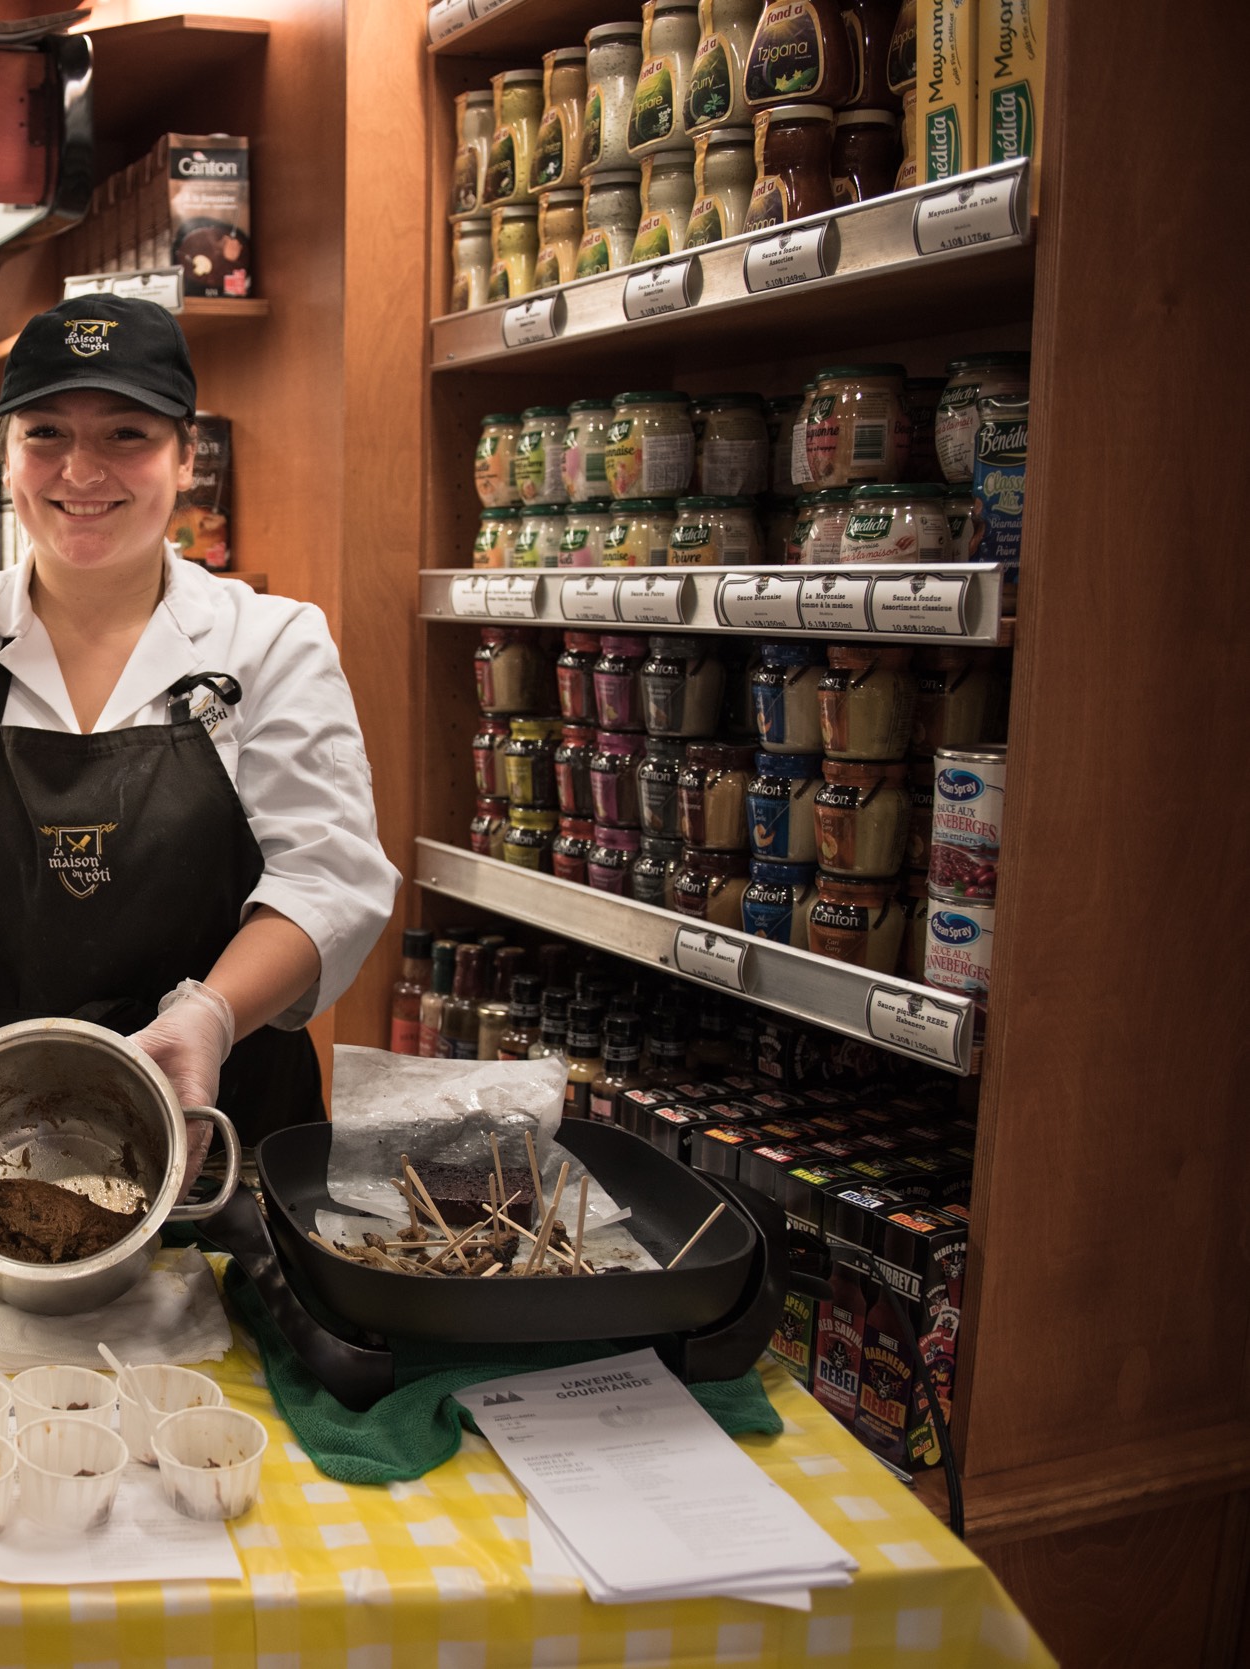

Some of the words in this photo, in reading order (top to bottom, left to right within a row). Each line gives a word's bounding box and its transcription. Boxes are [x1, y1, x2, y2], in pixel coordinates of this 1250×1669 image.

[767, 8, 792, 26] fond
[993, 0, 1017, 78] Mayon
[758, 40, 808, 63] Tzigana
[929, 0, 947, 103] Mayonna
[691, 74, 715, 92] Curry
[996, 91, 1018, 164] nédicta
[931, 116, 949, 181] nédicta
[178, 157, 238, 177] Canton
[928, 203, 968, 218] Mayonnaise
[980, 195, 998, 206] Tube
[762, 250, 778, 260] Sauce
[783, 244, 802, 255] fondue
[64, 334, 103, 346] maison
[91, 341, 110, 352] rôti
[807, 426, 840, 441] gnonne
[979, 424, 1028, 457] Bénédic
[990, 514, 1023, 528] Béarnais
[996, 531, 1021, 543] Tartare
[671, 552, 701, 563] Poivre
[996, 545, 1017, 556] Poivre
[737, 593, 753, 602] Sauce
[754, 592, 782, 601] Béarnaise
[805, 592, 814, 600] La
[892, 593, 912, 602] Sauce
[918, 593, 942, 602] fondue
[881, 603, 920, 611] Assortiment
[921, 604, 953, 612] classique
[201, 705, 216, 719] on
[747, 782, 781, 796] Canton
[939, 775, 954, 796] Ocean
[953, 779, 977, 797] Spray
[816, 790, 848, 805] Canton
[957, 806, 976, 818] AUX
[934, 812, 997, 844] NNEBERGES
[950, 834, 978, 846] entiers
[53, 847, 65, 857] La
[49, 855, 102, 869] maison
[84, 867, 111, 883] rôti
[674, 874, 701, 894] Canton
[746, 888, 784, 903] Canton
[814, 909, 860, 928] Canton
[932, 918, 950, 937] Ocean
[949, 921, 972, 939] Spray
[680, 942, 694, 951] Sauce
[699, 947, 715, 957] fondue
[825, 943, 841, 953] Curry
[827, 938, 840, 946] Cari
[952, 948, 972, 962] AUX
[940, 974, 963, 986] gelée
[877, 1001, 896, 1012] Sauce
[897, 1007, 925, 1021] piquante
[926, 1015, 950, 1029] REBEL
[896, 1015, 926, 1031] Habanero
[792, 1169, 825, 1184] REBEL
[843, 1192, 879, 1208] REBEL
[891, 1214, 930, 1232] REBEL
[933, 1242, 967, 1262] REBEL-O-M
[910, 1280, 922, 1298] D.
[784, 1295, 810, 1320] APEÑO
[818, 1319, 833, 1332] RED
[771, 1332, 807, 1366] REBEL
[863, 1346, 911, 1380] HABANERO
[561, 1371, 635, 1390] L'AVENUE
[820, 1360, 857, 1394] REBEL
[556, 1378, 653, 1400] GOURMANDE
[863, 1388, 904, 1427] REBEL
